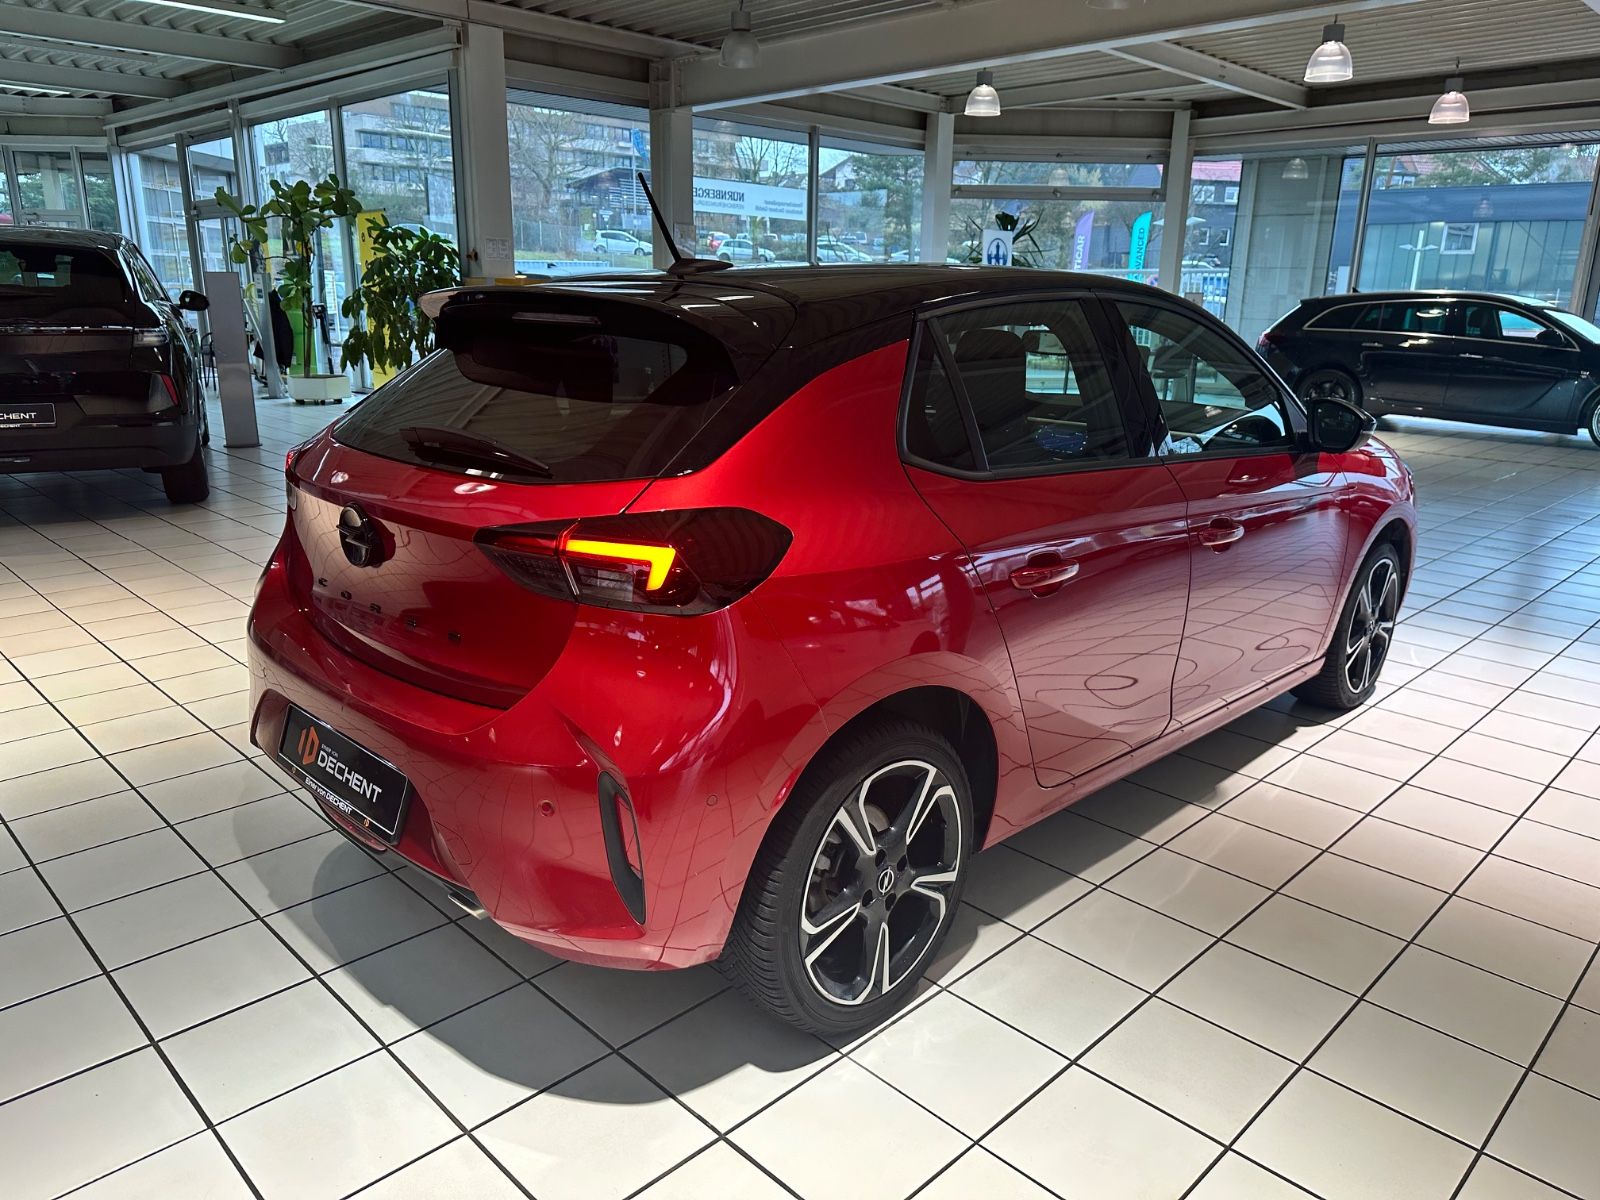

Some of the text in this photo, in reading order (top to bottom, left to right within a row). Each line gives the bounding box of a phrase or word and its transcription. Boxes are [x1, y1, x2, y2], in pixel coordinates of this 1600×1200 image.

[317, 750, 382, 803] DECHENT
[317, 787, 326, 798] von
[326, 792, 353, 815] DECHENT
